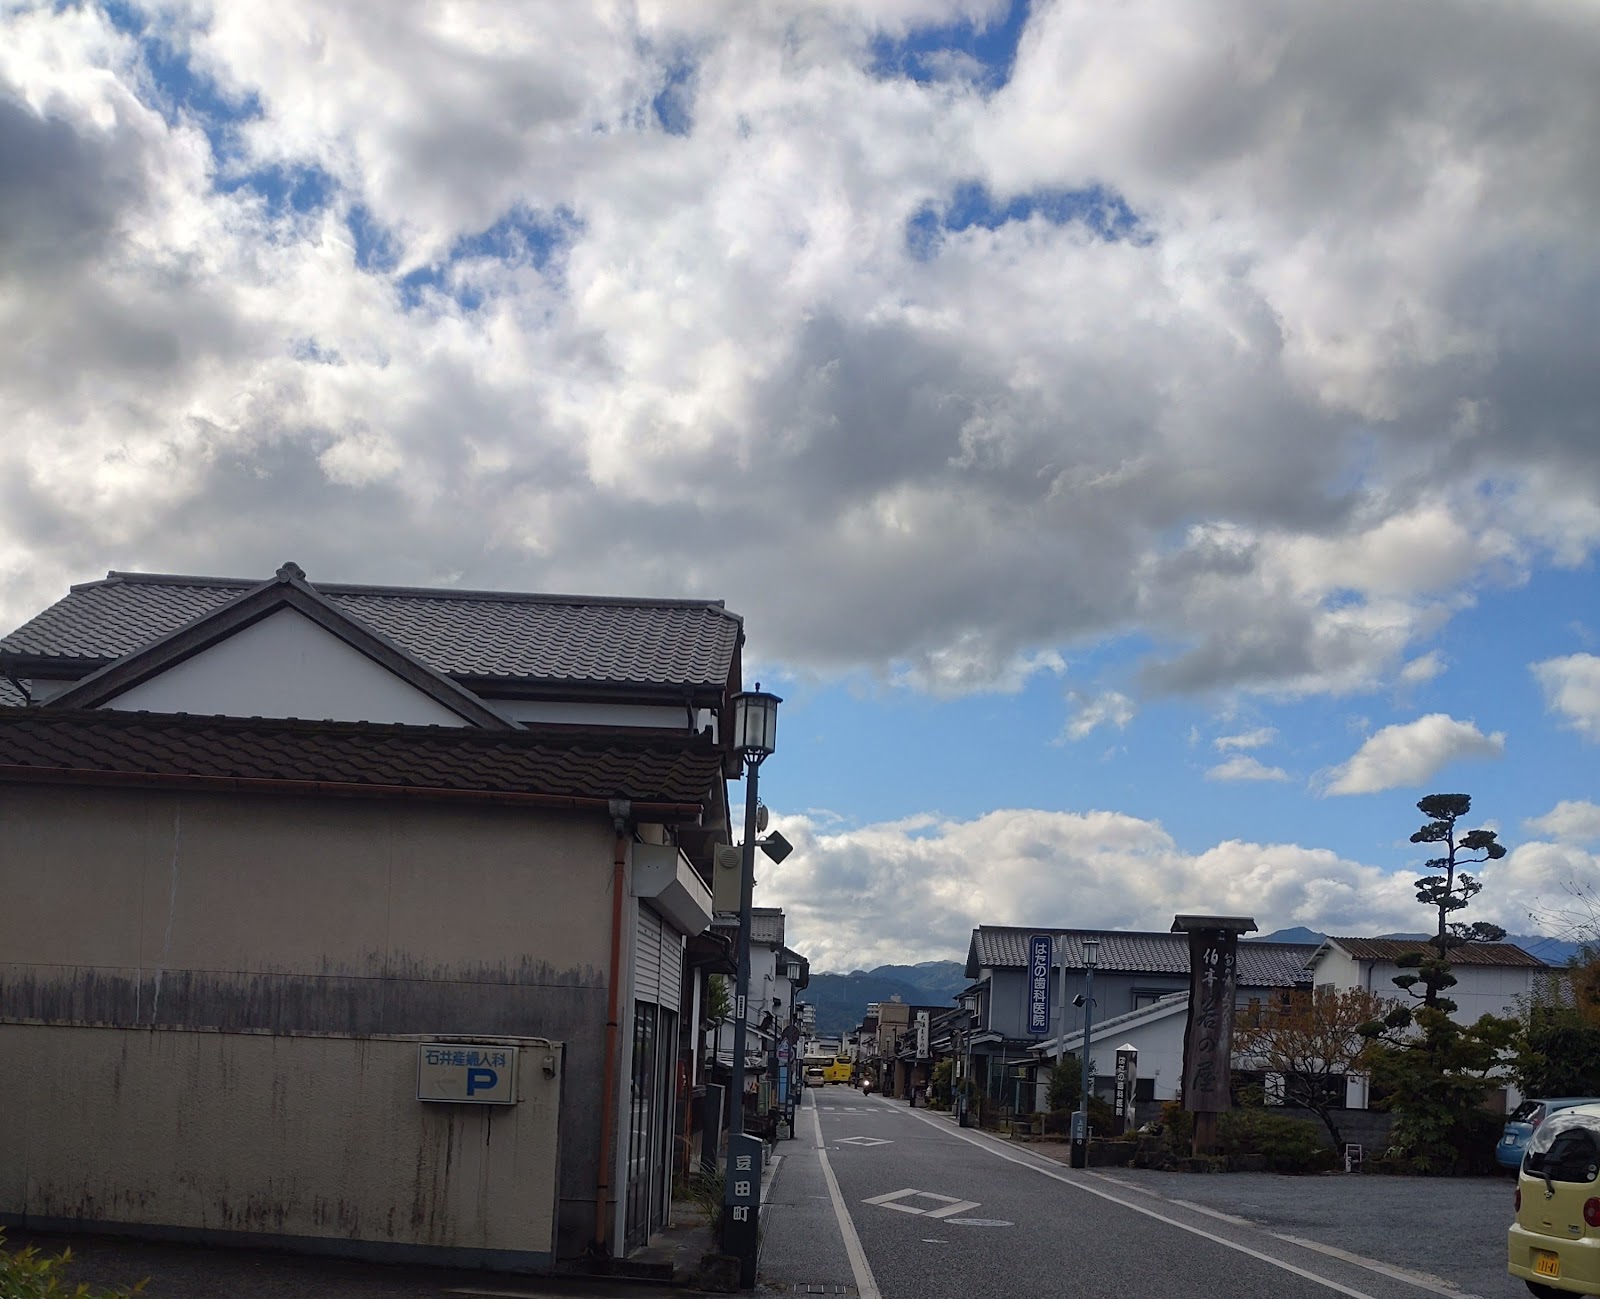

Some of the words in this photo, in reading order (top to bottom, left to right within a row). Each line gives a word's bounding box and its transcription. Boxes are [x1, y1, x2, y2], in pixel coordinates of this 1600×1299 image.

[1033, 943, 1047, 1027] はたの歯科医院
[425, 1050, 506, 1067] 石井産婦人科
[466, 1067, 498, 1096] P
[733, 1155, 752, 1222] 豆田町
